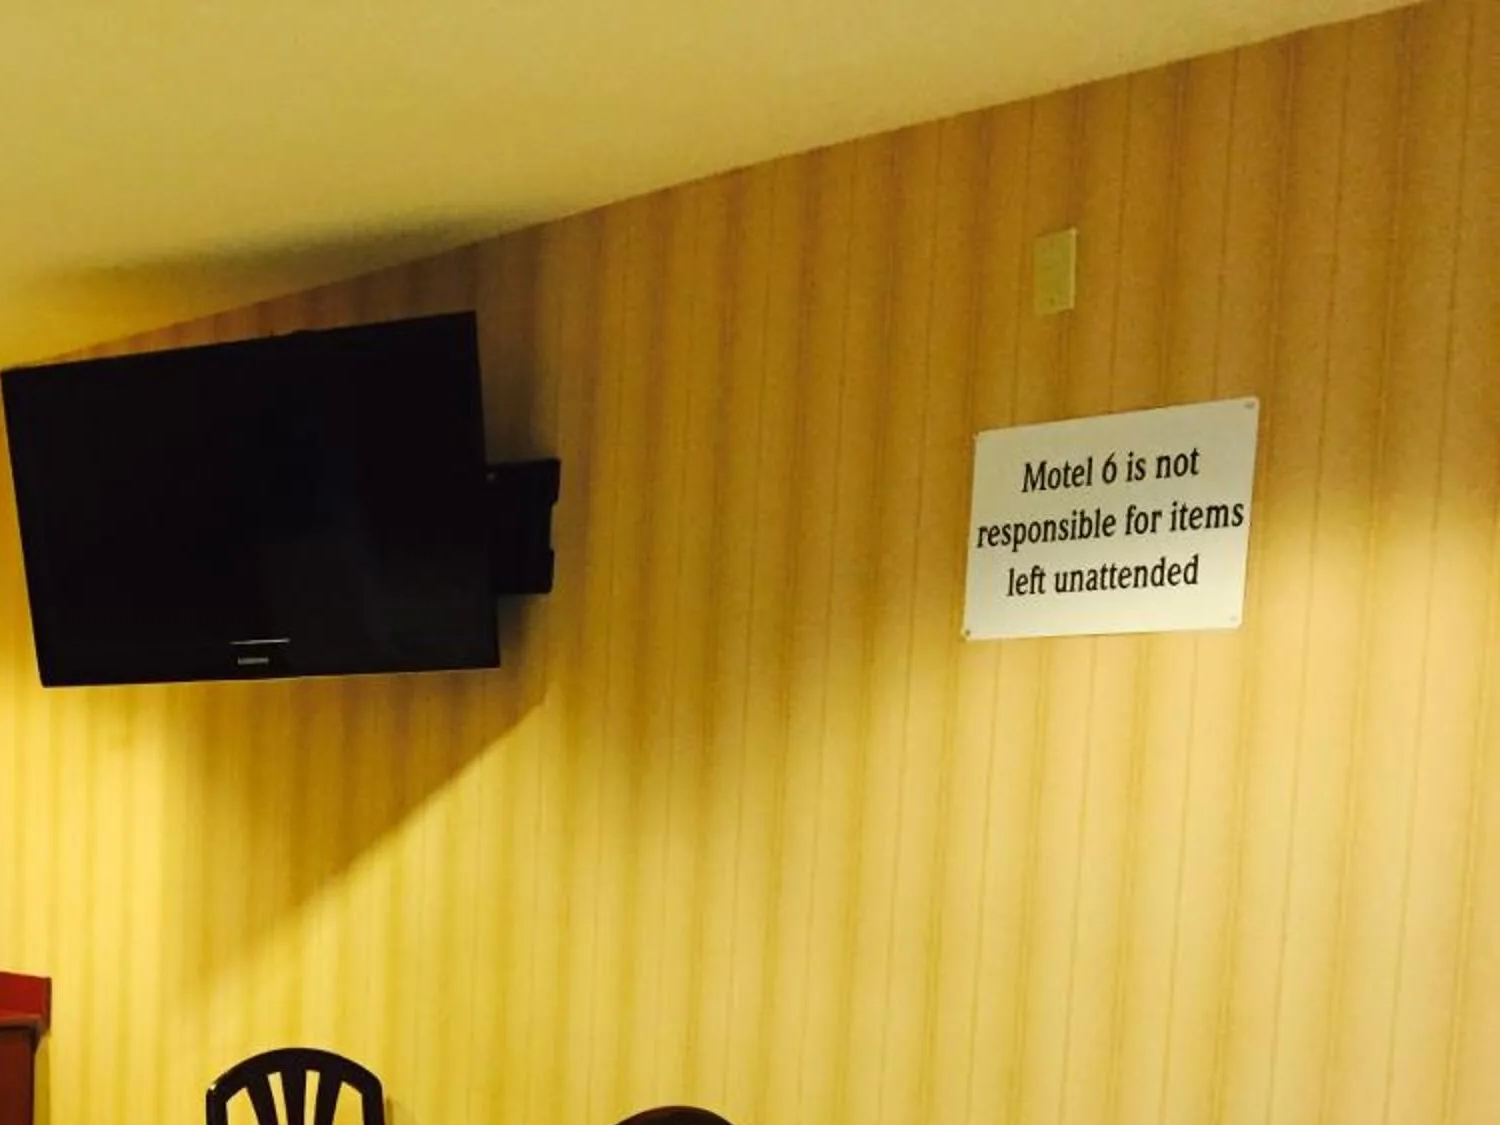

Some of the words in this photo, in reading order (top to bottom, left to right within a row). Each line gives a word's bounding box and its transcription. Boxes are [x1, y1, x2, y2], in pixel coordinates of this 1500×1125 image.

[1021, 456, 1094, 493] Motel
[1101, 452, 1118, 484] 6
[1126, 451, 1147, 483] is
[1155, 447, 1200, 478] not
[976, 508, 1117, 552] responsible
[1124, 504, 1162, 535] for
[1169, 500, 1245, 532] items
[1006, 565, 1047, 597] left
[1054, 553, 1200, 593] unattended
